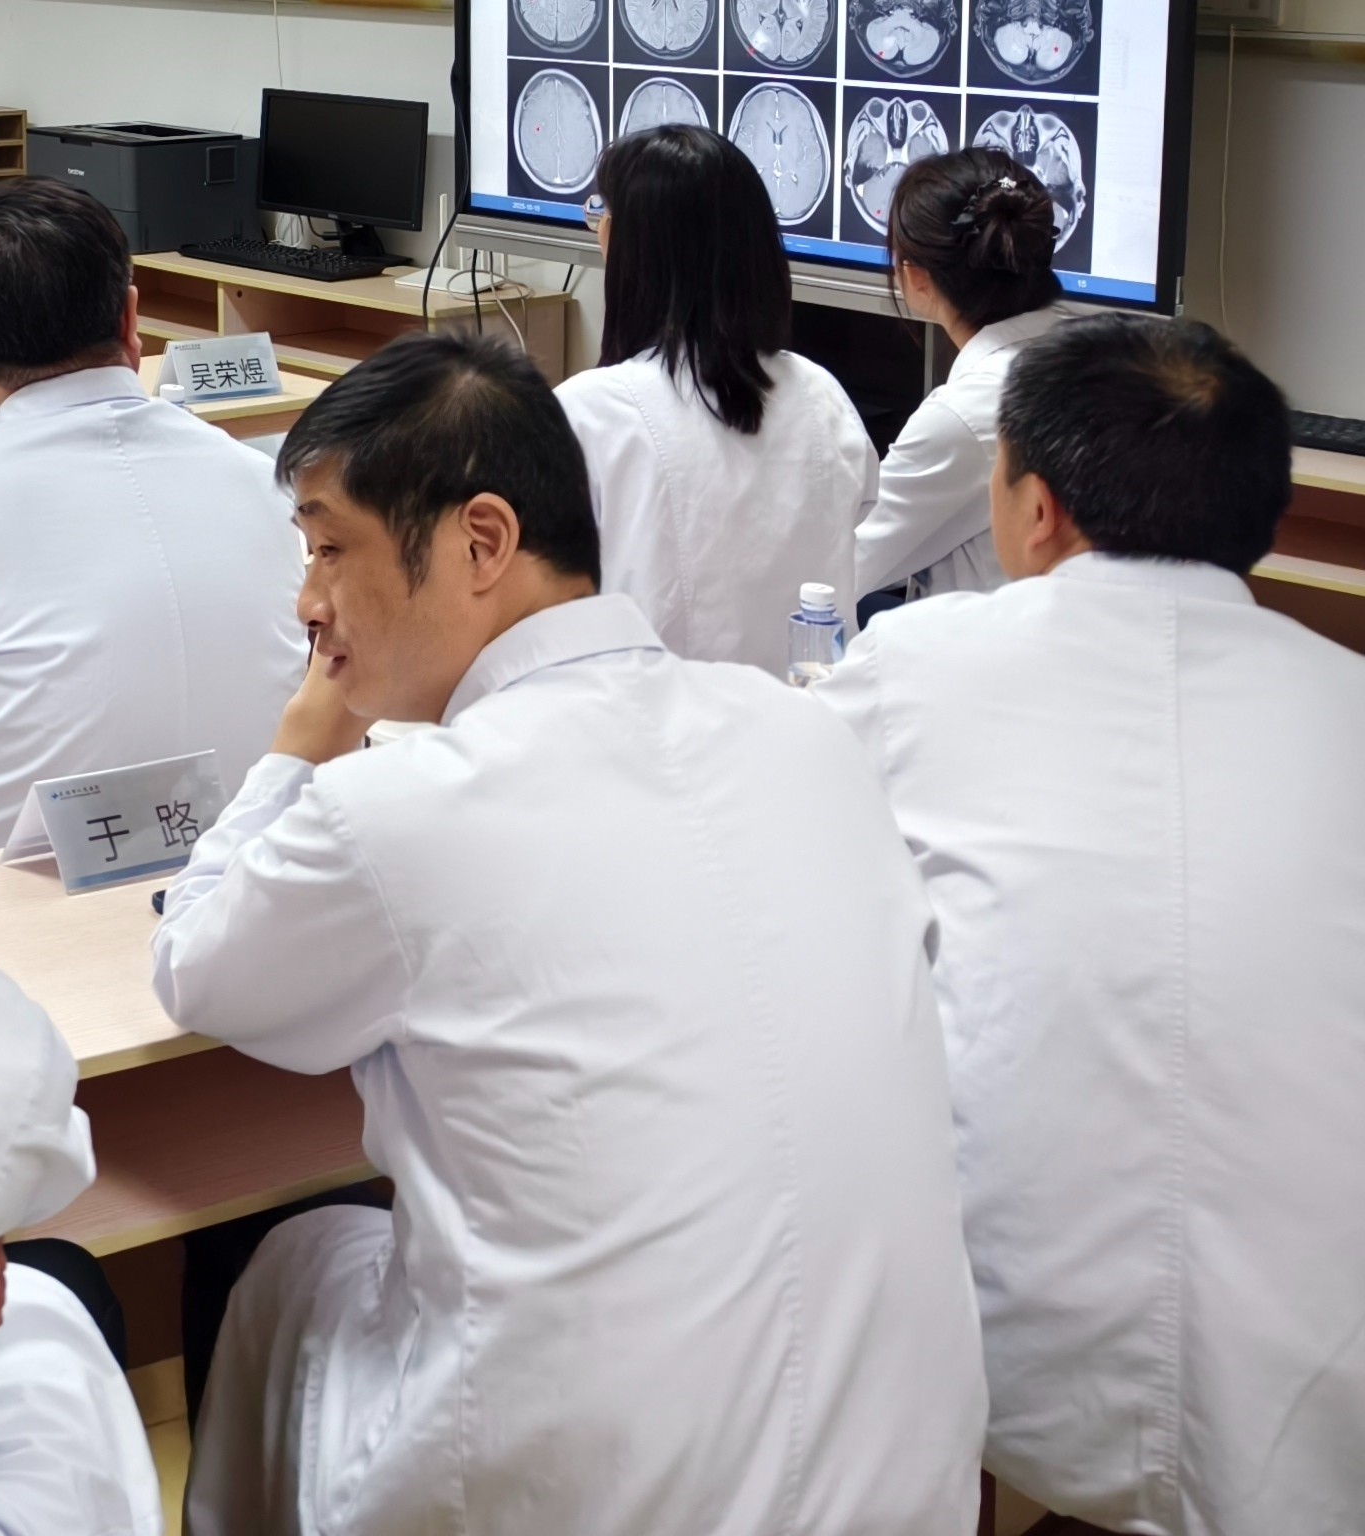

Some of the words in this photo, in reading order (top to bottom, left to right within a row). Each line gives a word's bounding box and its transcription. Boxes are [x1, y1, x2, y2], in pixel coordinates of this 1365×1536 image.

[191, 358, 267, 391] 吴荣煜
[86, 800, 201, 862] 于路
